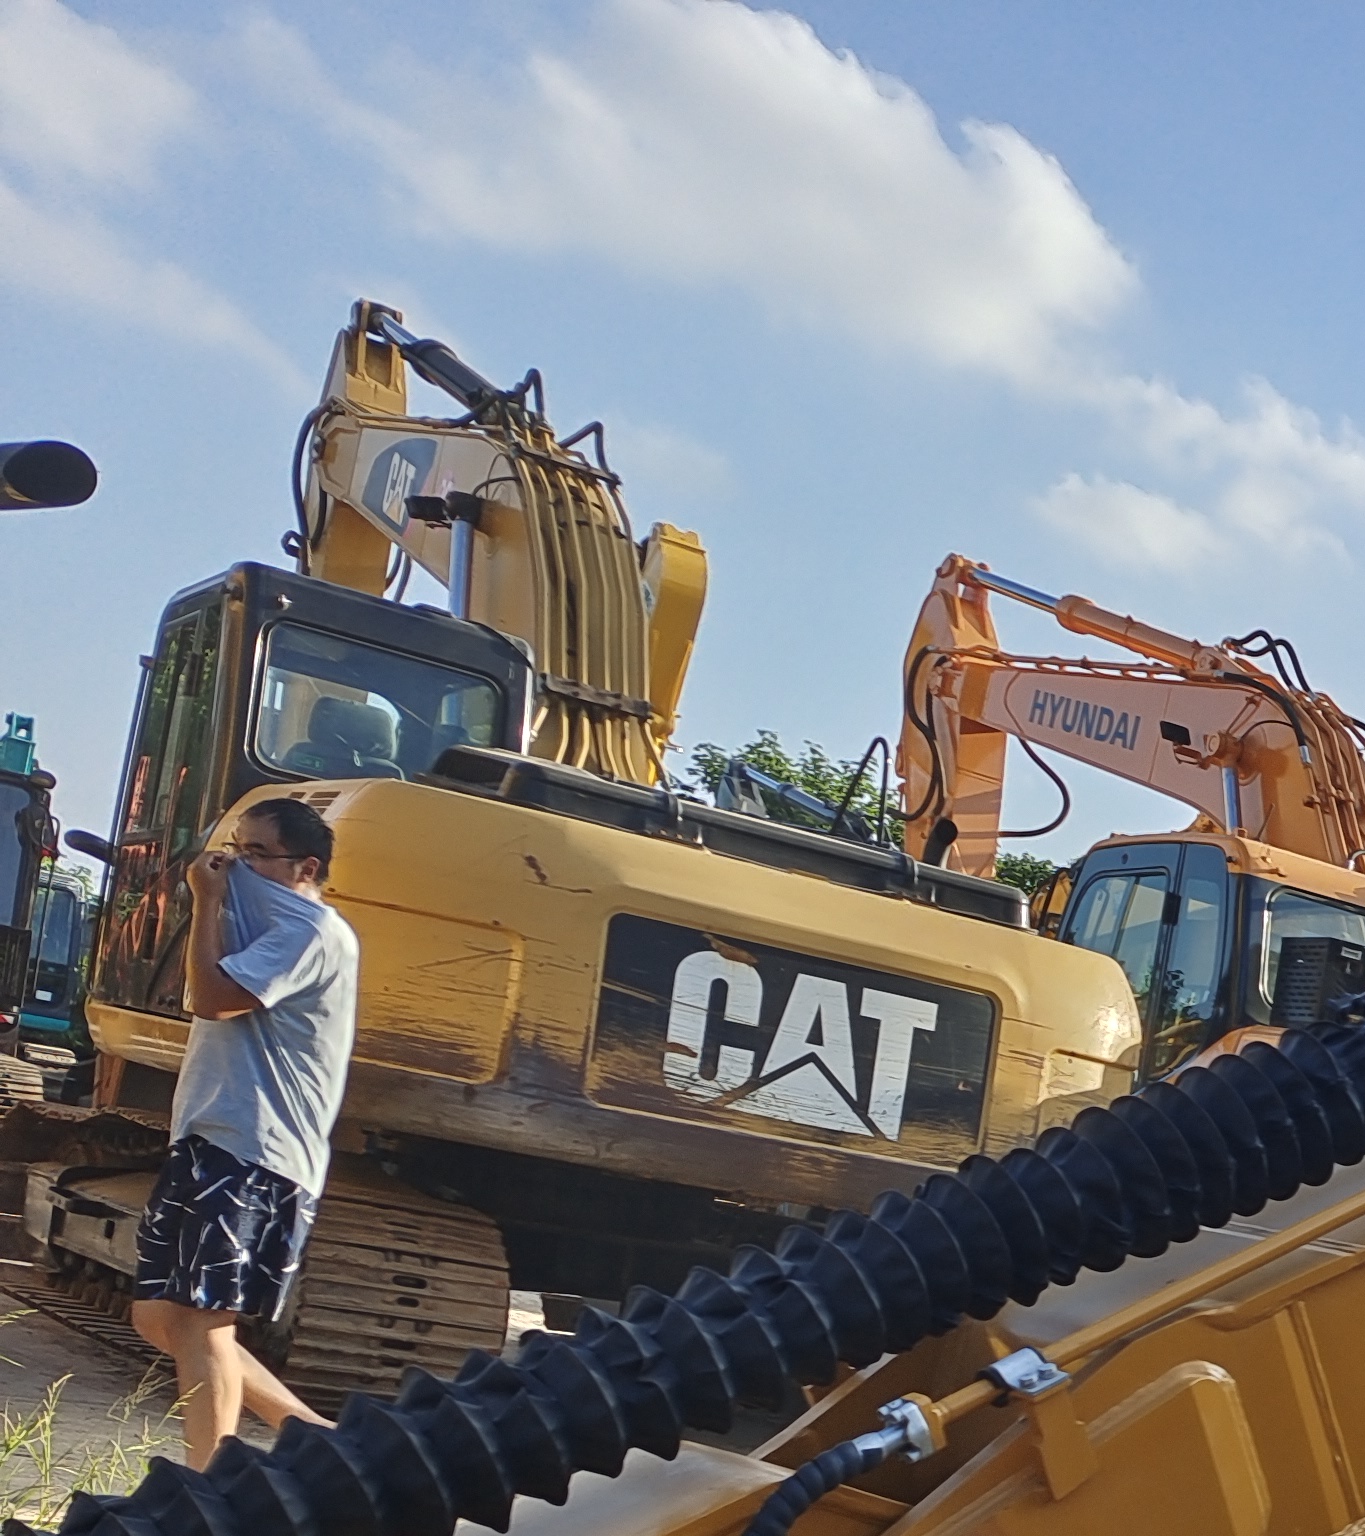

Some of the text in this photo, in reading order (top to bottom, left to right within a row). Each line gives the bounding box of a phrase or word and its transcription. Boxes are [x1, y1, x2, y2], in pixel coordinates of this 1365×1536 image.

[382, 452, 417, 526] CAT
[1029, 689, 1141, 750] HYUNDAI
[662, 950, 939, 1142] CAT
